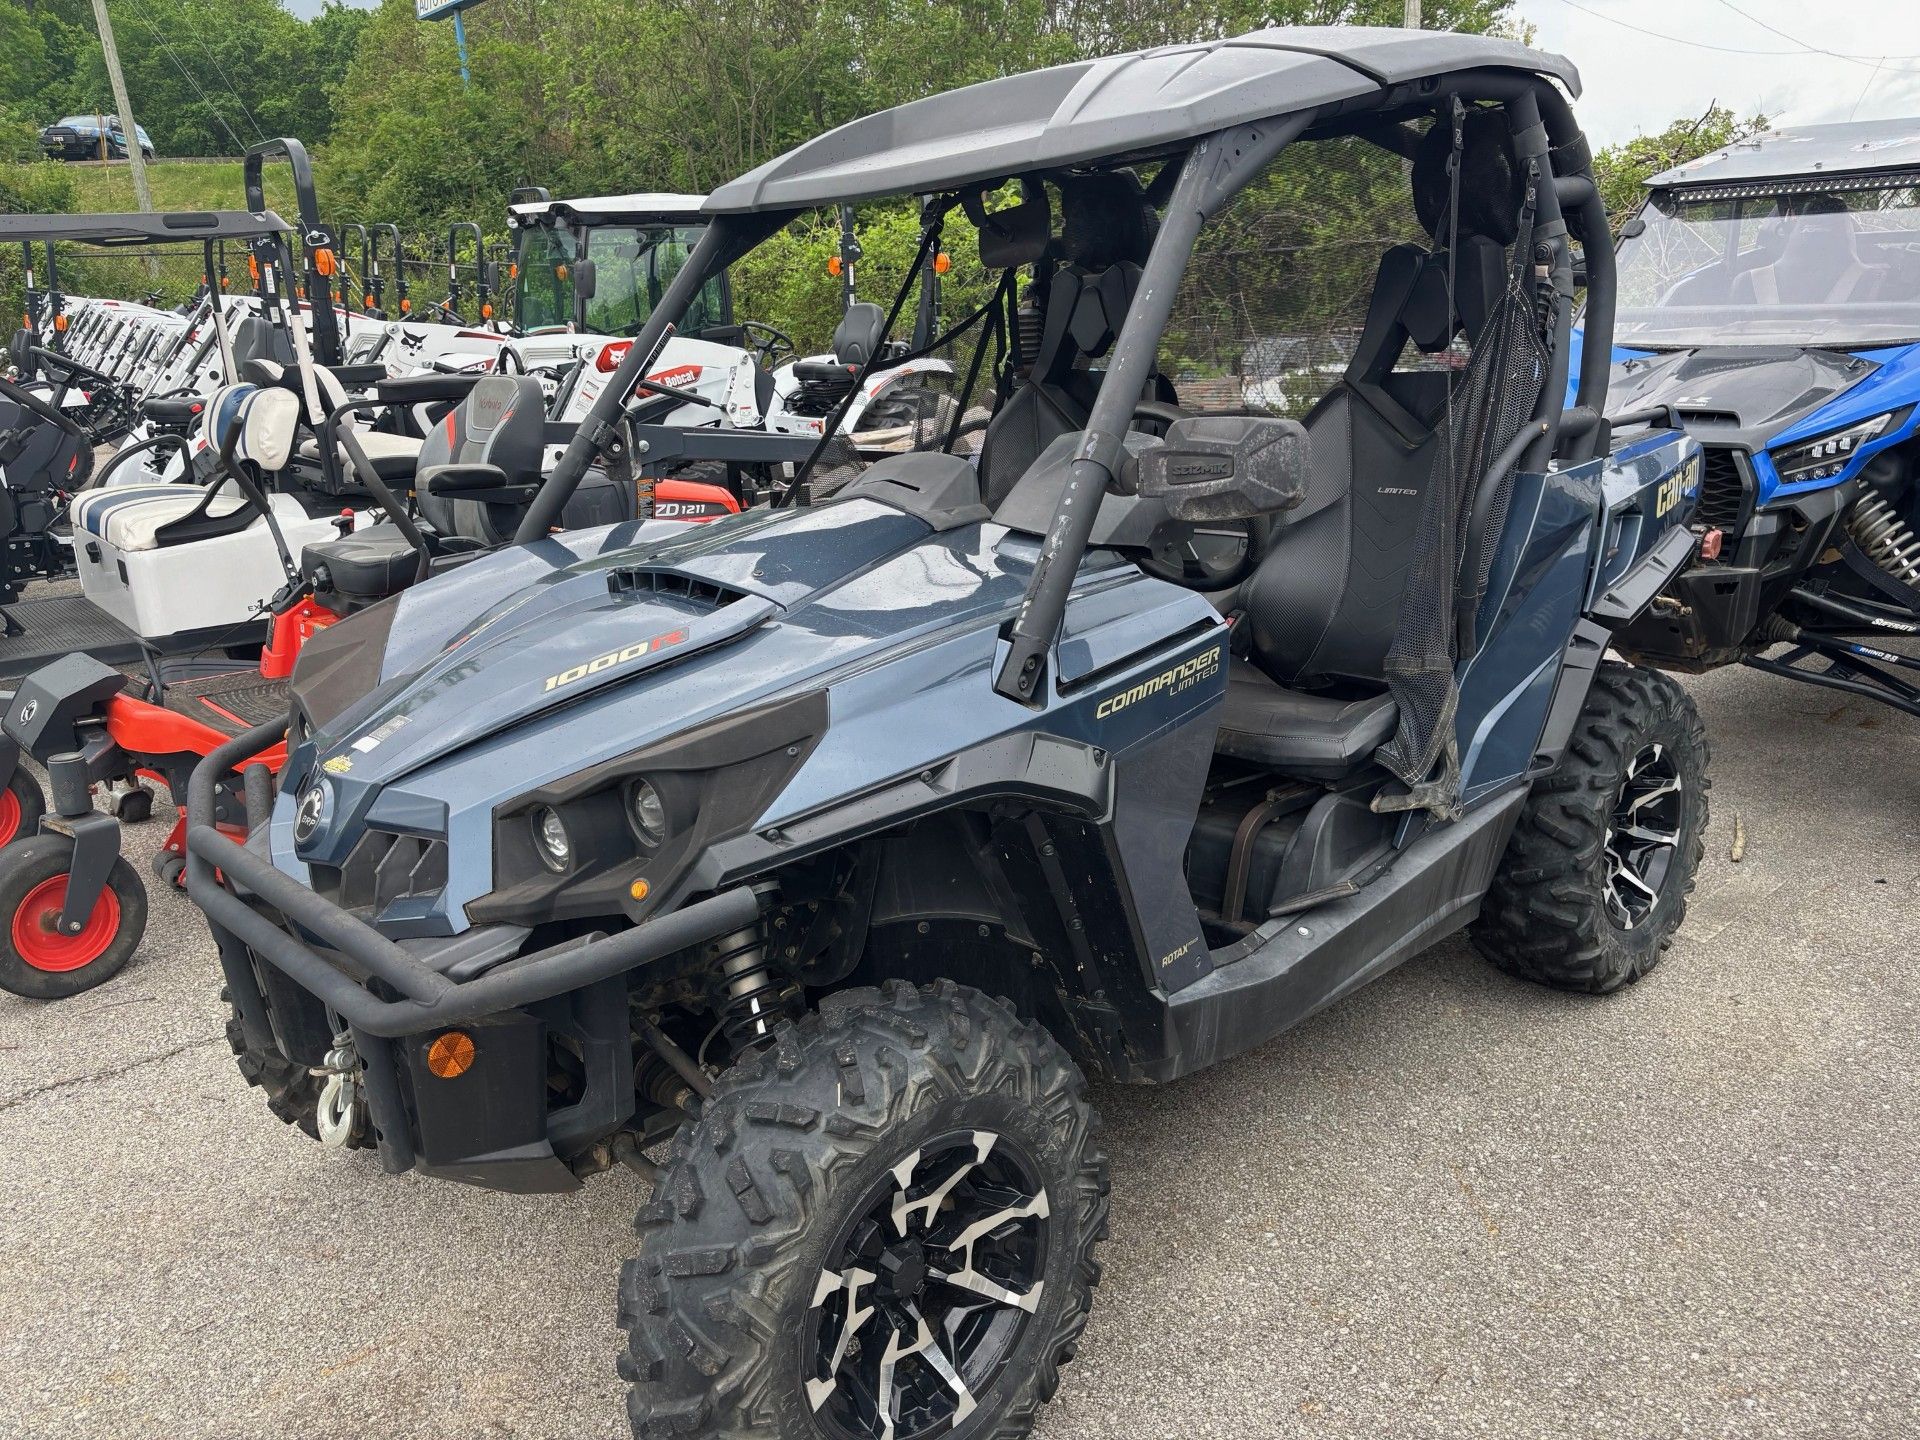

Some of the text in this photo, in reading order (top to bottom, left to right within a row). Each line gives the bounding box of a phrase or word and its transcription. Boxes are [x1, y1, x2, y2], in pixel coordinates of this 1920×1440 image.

[664, 370, 696, 387] Bobcat
[542, 383, 555, 391] FL8
[1172, 463, 1228, 476] SEIZMIK
[1377, 486, 1418, 496] LIMITED
[1859, 646, 1885, 658] RHINO
[1096, 646, 1221, 720] COMMANDER
[1169, 663, 1219, 696] LIMITED
[301, 814, 316, 827] BRP
[1161, 943, 1189, 968] ROTAX
